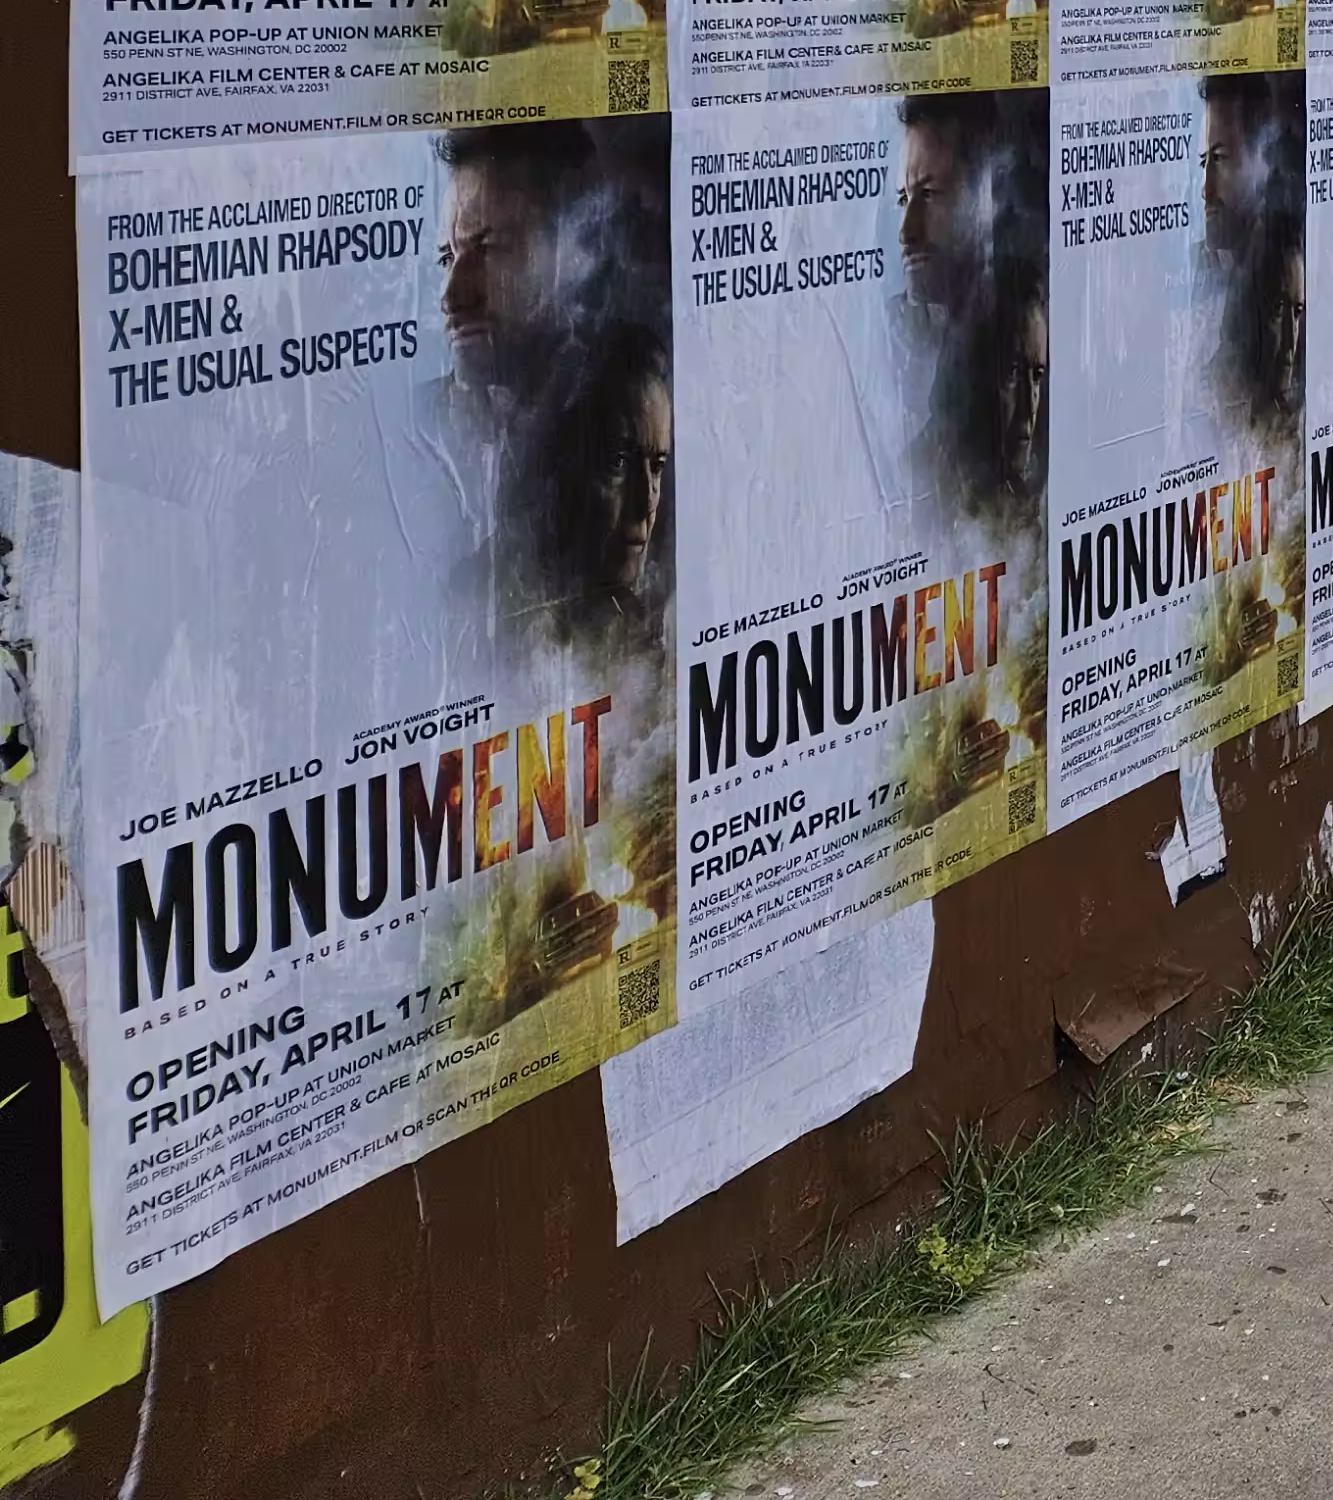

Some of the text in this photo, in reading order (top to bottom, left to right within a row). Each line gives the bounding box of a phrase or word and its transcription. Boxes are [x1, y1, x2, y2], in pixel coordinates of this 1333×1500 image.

[103, 49, 126, 60] 550
[128, 47, 164, 60] PENN
[166, 47, 184, 59] ST
[295, 43, 312, 54] DC
[313, 42, 347, 54] 20002
[104, 25, 444, 51] ANGELIKA POP-UP AT UNION MARKET
[103, 60, 489, 87] ANGELIKA FILM CENTER & CAFE AT MOSAIC
[103, 90, 134, 103] 2911
[136, 87, 193, 103] DISTRICT
[279, 83, 296, 95] VA
[297, 82, 329, 95] 22031
[103, 130, 138, 143] GET
[142, 125, 216, 141] TICKETS
[221, 124, 243, 136] AT
[247, 116, 381, 134] MONUMENT.FILM
[387, 115, 407, 126] OR
[412, 112, 452, 124] SCAN
[508, 106, 545, 118] CODE
[692, 167, 888, 217] BOHEMIAN RHAPSODY
[1062, 179, 1114, 212] X-MEN &
[109, 218, 424, 294] BOHEMIAN RHAPSODY
[692, 221, 776, 262] X-MEN &
[692, 248, 883, 306] THE USUAL SUSPECTS
[109, 294, 242, 352] X-MEN &
[109, 320, 417, 407] THE USUAL SUSPECTS
[1061, 468, 1274, 637] MONUMENT
[689, 563, 1005, 781] MONUMENT
[1062, 649, 1136, 696] OPENING
[1127, 659, 1172, 692] APRIL
[1176, 648, 1192, 668] 17
[1195, 645, 1208, 661] AT
[345, 704, 492, 764] JON VOIGHT
[120, 759, 322, 841] JOE MAZZELLO
[690, 790, 805, 853] OPENING
[790, 799, 861, 844] APRIL
[868, 783, 890, 809] 17
[894, 780, 908, 800] AT
[118, 696, 611, 1011] MONUMENT
[127, 1006, 304, 1101] OPENING
[129, 980, 464, 1144] FRIDAY, APRIL 17 AT
